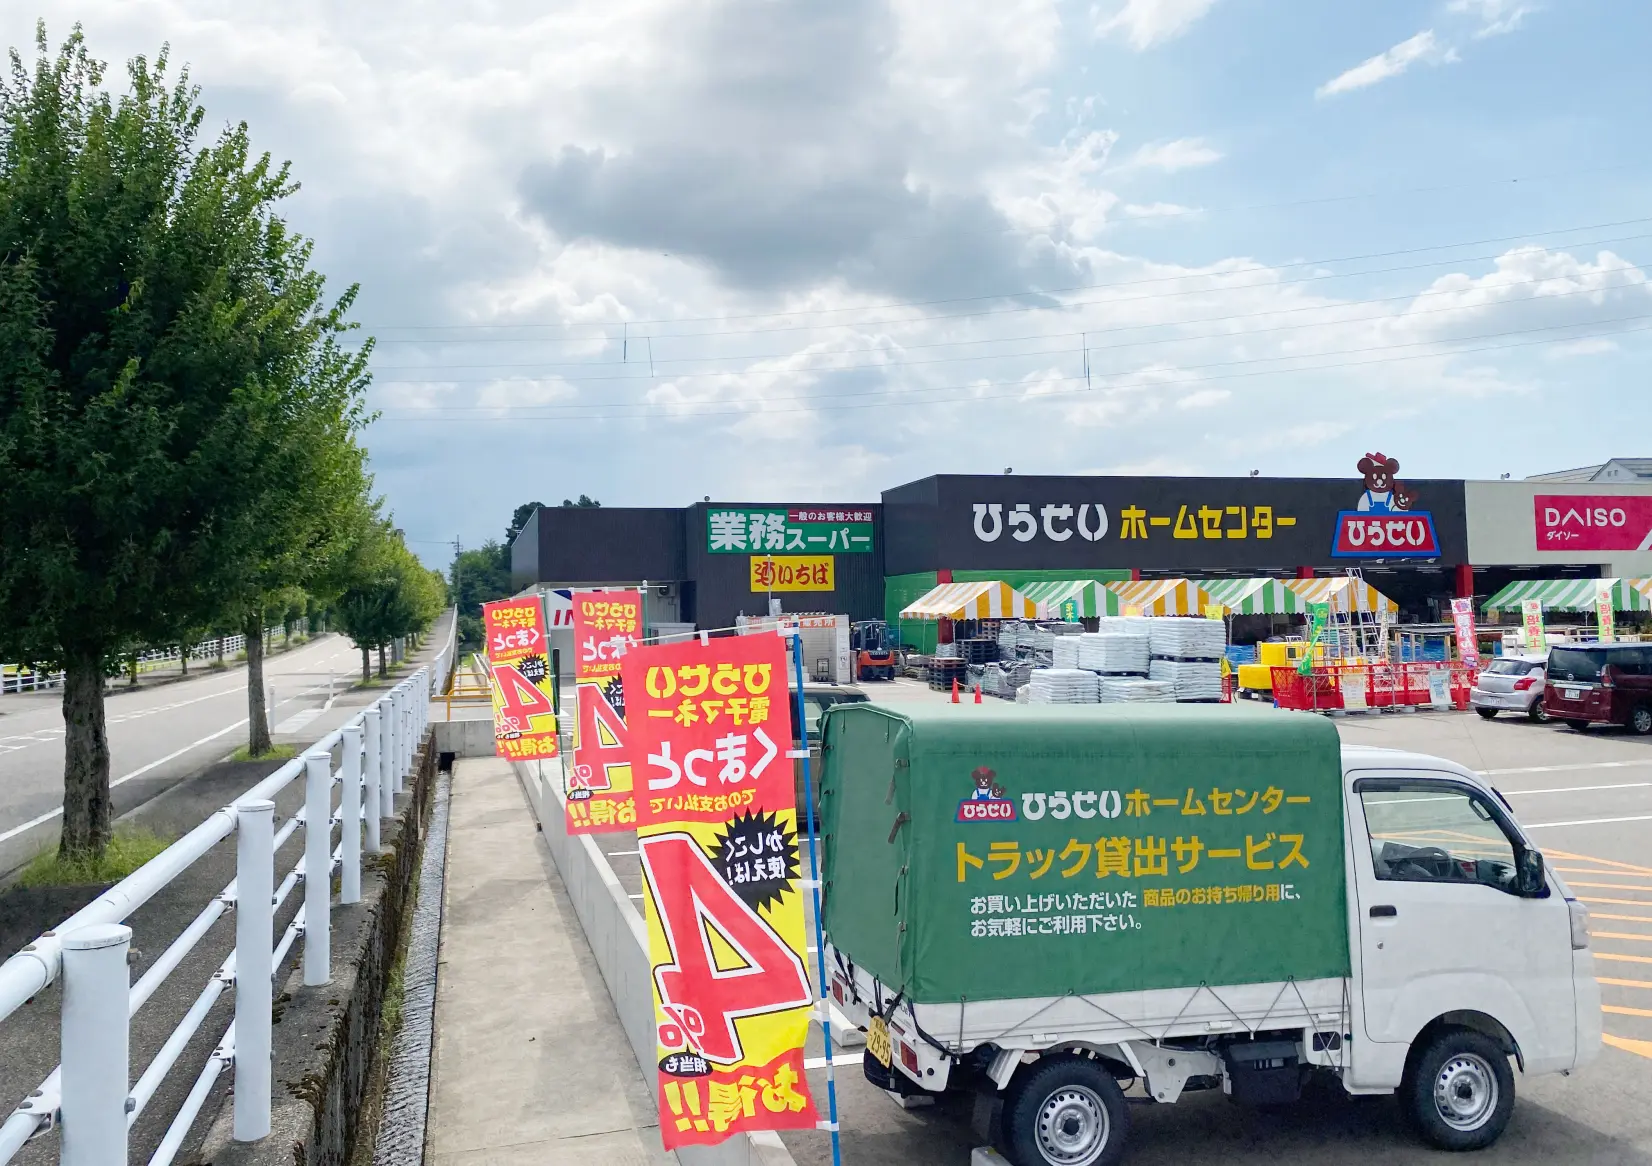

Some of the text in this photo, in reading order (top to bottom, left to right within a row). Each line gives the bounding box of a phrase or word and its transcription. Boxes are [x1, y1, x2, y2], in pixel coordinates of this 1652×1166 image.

[789, 512, 872, 522] 一般のお客様大歓迎
[971, 503, 1297, 542] ひらせい ホームセンター
[1545, 508, 1627, 528] DAISO
[709, 512, 871, 551] 業務スーパー
[1347, 520, 1426, 547] ひらせい
[1546, 531, 1580, 541] ダイソー
[962, 802, 1012, 819] ひらせい
[1021, 785, 1311, 820] ひらせい ホームセンター
[956, 831, 1311, 883] トラック貸出サービス
[970, 883, 1302, 915] お買い上げいただいた 商品のお持ち帰り用に、
[970, 914, 1142, 938] お気軽にご利用下さい。
